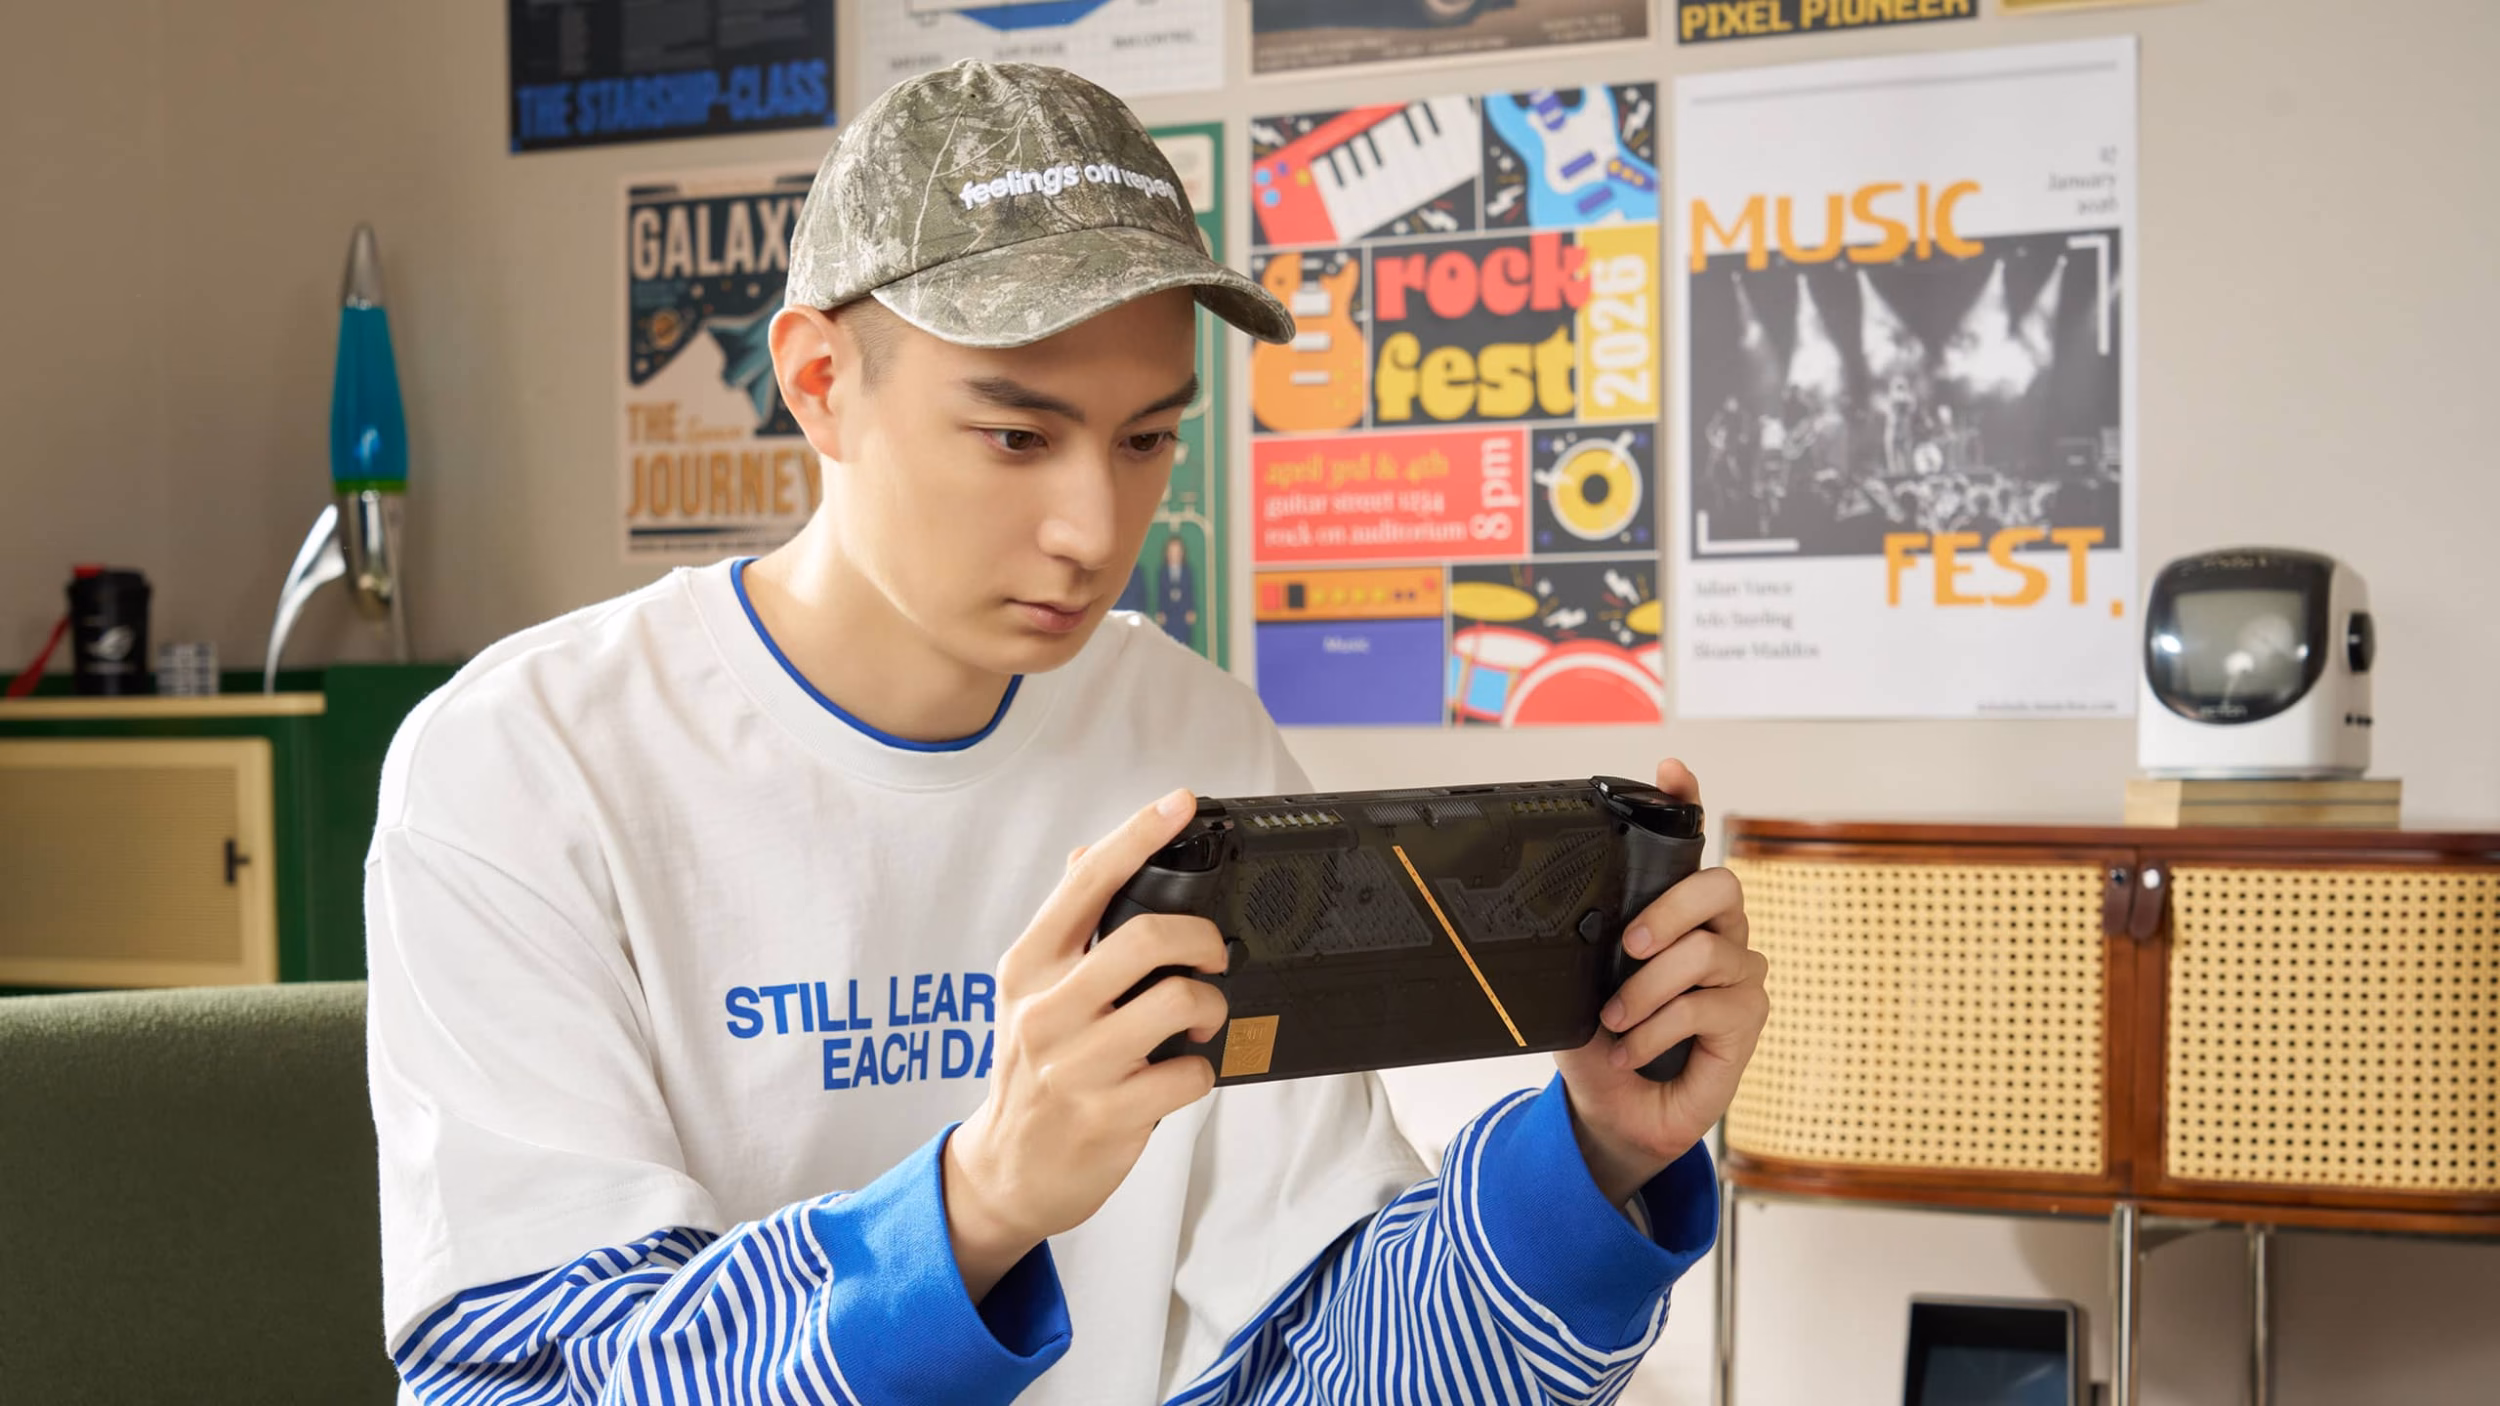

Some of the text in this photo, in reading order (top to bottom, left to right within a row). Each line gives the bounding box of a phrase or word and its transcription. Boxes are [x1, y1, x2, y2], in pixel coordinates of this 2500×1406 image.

[1681, 0, 1793, 40] PIXEL
[517, 57, 828, 140] THE STARSHIP-CLASS
[959, 163, 1181, 211] feelings on repea
[632, 197, 803, 280] GALAX
[1690, 180, 1985, 274] MUSIC
[1374, 231, 1592, 321] rock
[1589, 254, 1648, 407] 2026
[1375, 325, 1576, 421] fest
[628, 402, 677, 443] THE
[1264, 489, 1329, 520] guitar
[1332, 488, 1395, 514] street
[1375, 452, 1399, 481] &
[1469, 437, 1520, 540] 8 pm
[725, 972, 996, 1039] STILL LEAR
[823, 1030, 930, 1090] EACH
